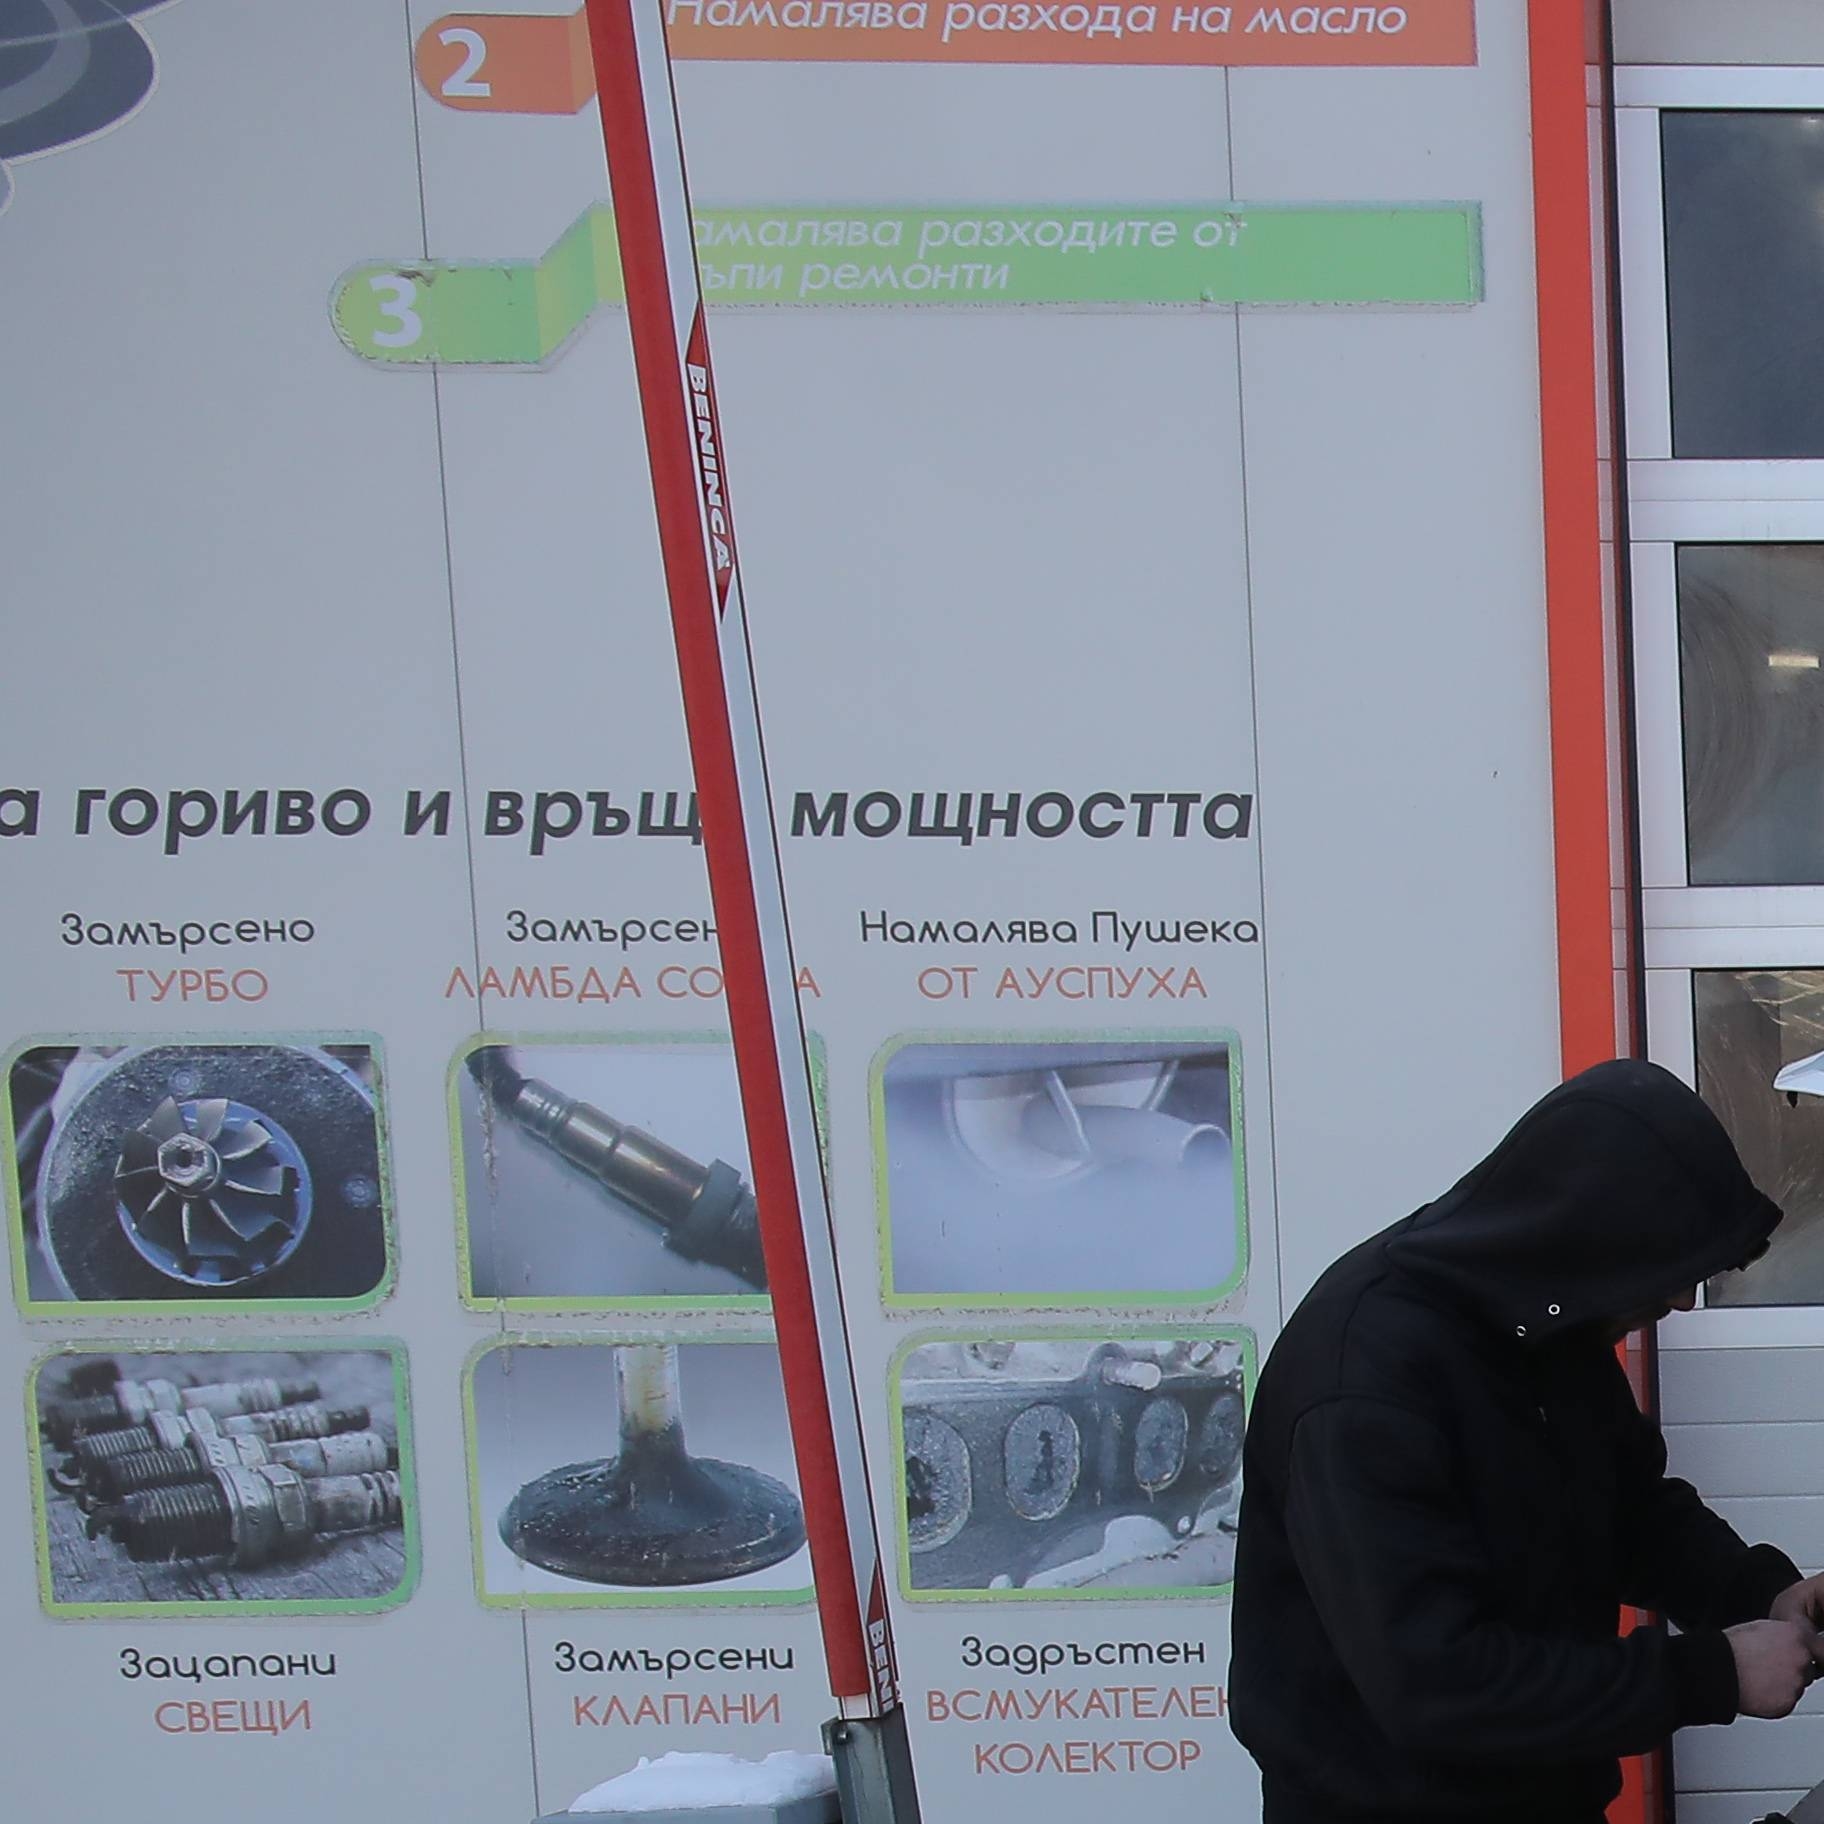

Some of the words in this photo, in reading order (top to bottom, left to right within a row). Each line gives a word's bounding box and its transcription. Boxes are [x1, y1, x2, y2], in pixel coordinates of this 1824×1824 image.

[942, 1, 1157, 43] разхода
[1172, 3, 1232, 33] на
[1245, 5, 1407, 34] масло
[440, 28, 491, 97] 2
[695, 219, 902, 247] амалява
[918, 216, 1177, 259] разходите
[1193, 218, 1247, 246] от
[798, 261, 1009, 298] ремонти
[369, 274, 423, 348] 3
[686, 363, 731, 571] BENINCA
[74, 787, 371, 855] гориво
[403, 788, 450, 837] и
[484, 788, 704, 856] връщ
[791, 792, 1253, 846] мощността
[61, 913, 316, 953] Замърсено
[507, 910, 718, 951] Замърсен
[860, 910, 1077, 944] Намалява
[1092, 911, 1259, 952] Пушека
[116, 969, 269, 1002] ТУРБО
[444, 966, 640, 1004] ЛАМБДА
[657, 966, 821, 999] СОА
[917, 966, 977, 999] ОТ
[996, 966, 1207, 999] АУСПУХА
[119, 1648, 336, 1684] Зацапани
[554, 1639, 794, 1678] Замърсени
[868, 1619, 895, 1714] BENI
[961, 1636, 1205, 1675] Задръстен
[155, 1699, 312, 1736] СВЕЩИ
[573, 1692, 781, 1727] КЛАПАНИ
[975, 1740, 1202, 1775] КОЛЕКТОР
